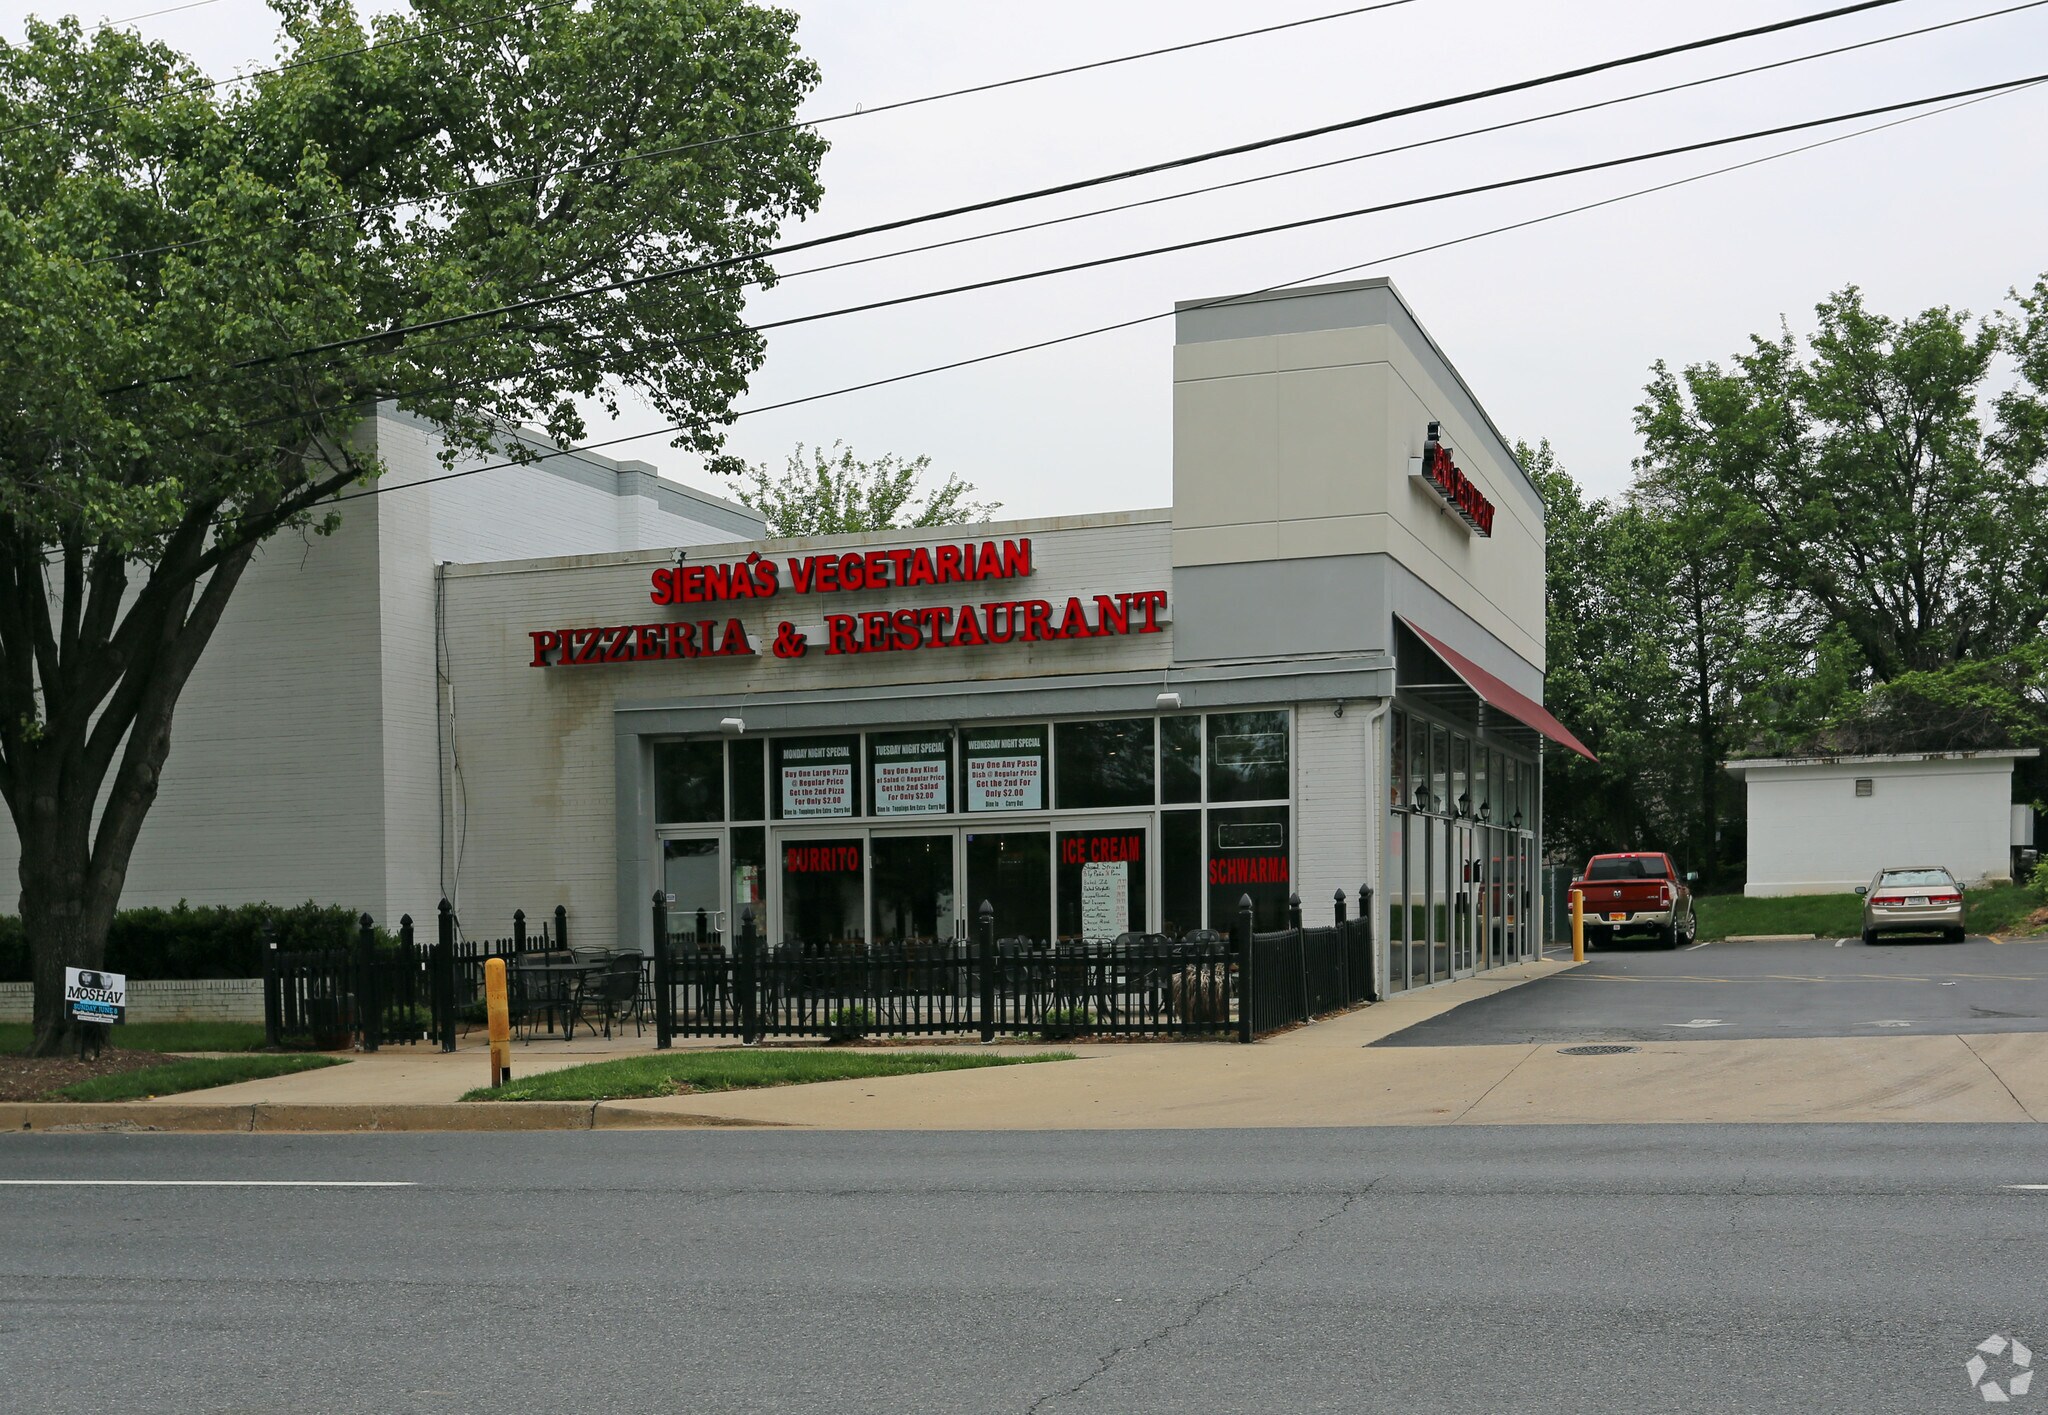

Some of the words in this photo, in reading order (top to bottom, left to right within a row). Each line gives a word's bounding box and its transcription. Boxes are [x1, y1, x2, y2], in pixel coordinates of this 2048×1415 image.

[787, 537, 1032, 594] VEGETARIAN
[529, 618, 756, 668] PIZZERIA
[772, 620, 808, 659] &
[823, 589, 1168, 656] RESTAURANT
[783, 748, 807, 759] MONDAY
[808, 748, 825, 758] NIGHT
[826, 747, 850, 757] SPECIAL
[875, 745, 901, 756] TUESDAY
[902, 744, 920, 754] NIGHT
[920, 742, 945, 753] SPECIAL
[968, 740, 1000, 749] WEDNESDAY
[1001, 739, 1018, 748] NIGHT
[1018, 738, 1040, 747] SPECIAL
[787, 846, 859, 872] BURRITO
[1062, 838, 1086, 864] ICE
[1090, 836, 1140, 862] CREAM
[1209, 857, 1289, 885] SCHWARMA
[68, 986, 123, 1004] MOSHAV
